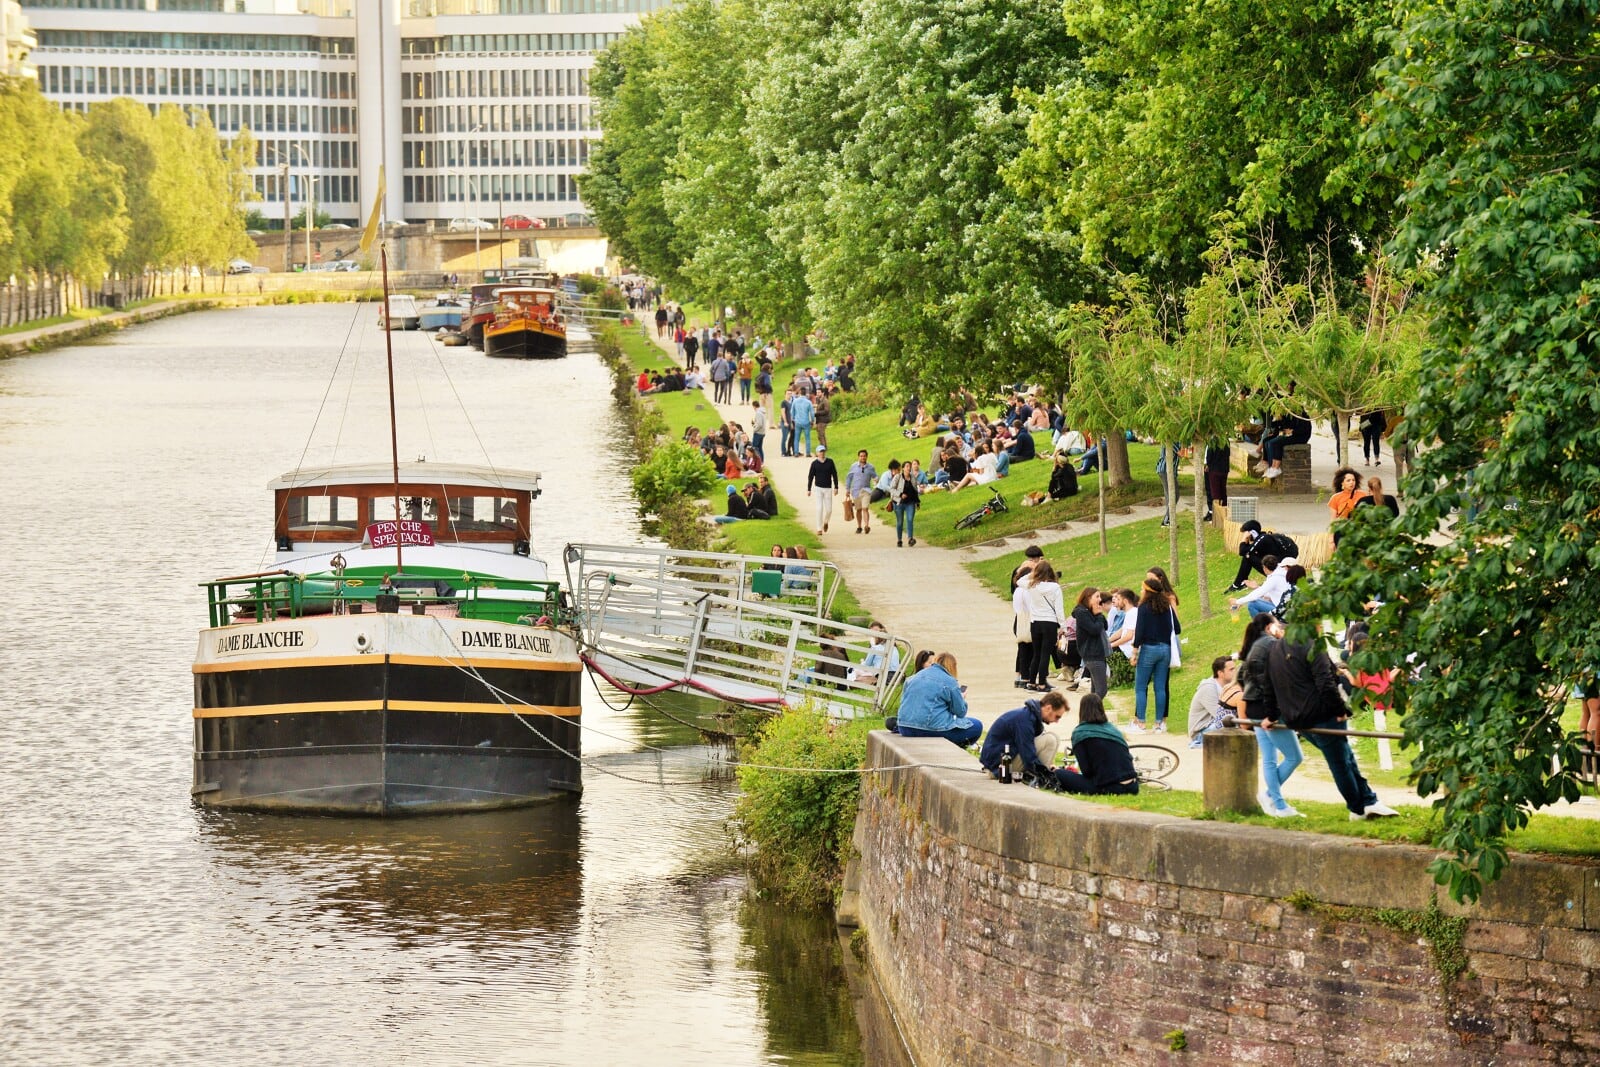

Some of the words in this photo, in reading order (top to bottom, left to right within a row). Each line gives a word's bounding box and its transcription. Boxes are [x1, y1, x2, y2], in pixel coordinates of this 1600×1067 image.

[377, 521, 422, 534] PENCHE
[217, 634, 240, 654] DAME
[242, 631, 304, 650] BLANCHE
[461, 631, 503, 648] DAME
[504, 633, 552, 654] BLANCHE
